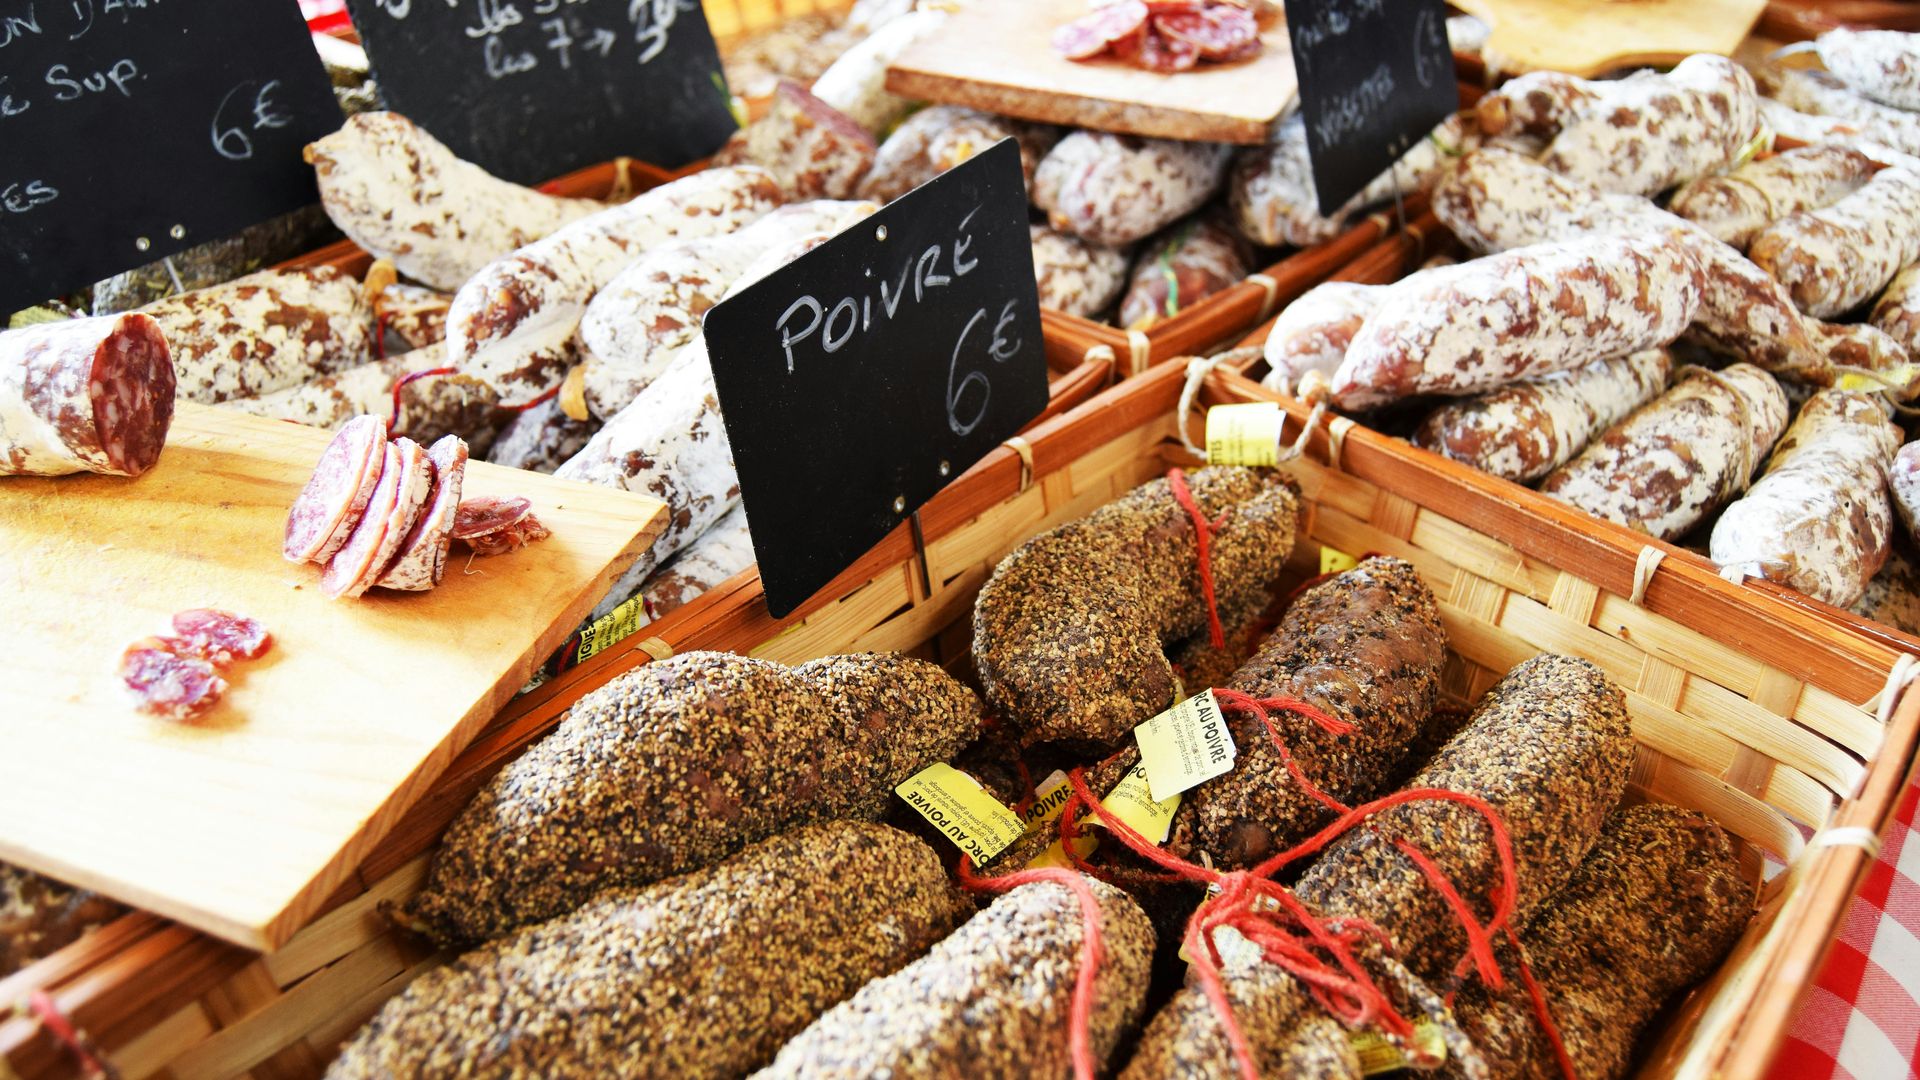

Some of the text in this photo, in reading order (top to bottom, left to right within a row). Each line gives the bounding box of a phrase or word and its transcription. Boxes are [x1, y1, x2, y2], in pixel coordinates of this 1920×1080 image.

[1196, 706, 1211, 723] AU
[1201, 722, 1227, 764] POIVRE
[906, 791, 951, 828] POIVRE
[947, 826, 970, 843] AU
